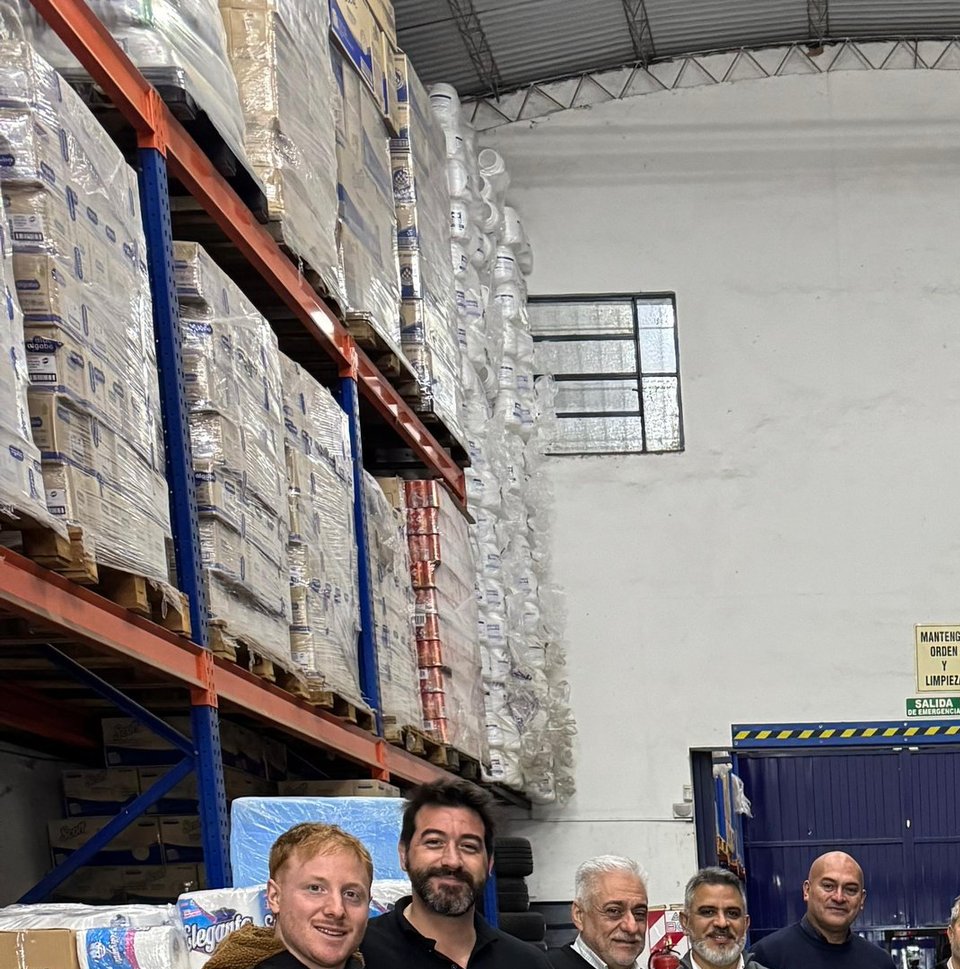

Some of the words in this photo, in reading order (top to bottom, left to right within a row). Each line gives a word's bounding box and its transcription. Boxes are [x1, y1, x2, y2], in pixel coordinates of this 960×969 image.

[930, 646, 958, 657] ORDEN
[941, 660, 947, 671] Y
[915, 699, 953, 709] SALIDA
[918, 707, 960, 715] EMERGENCIA
